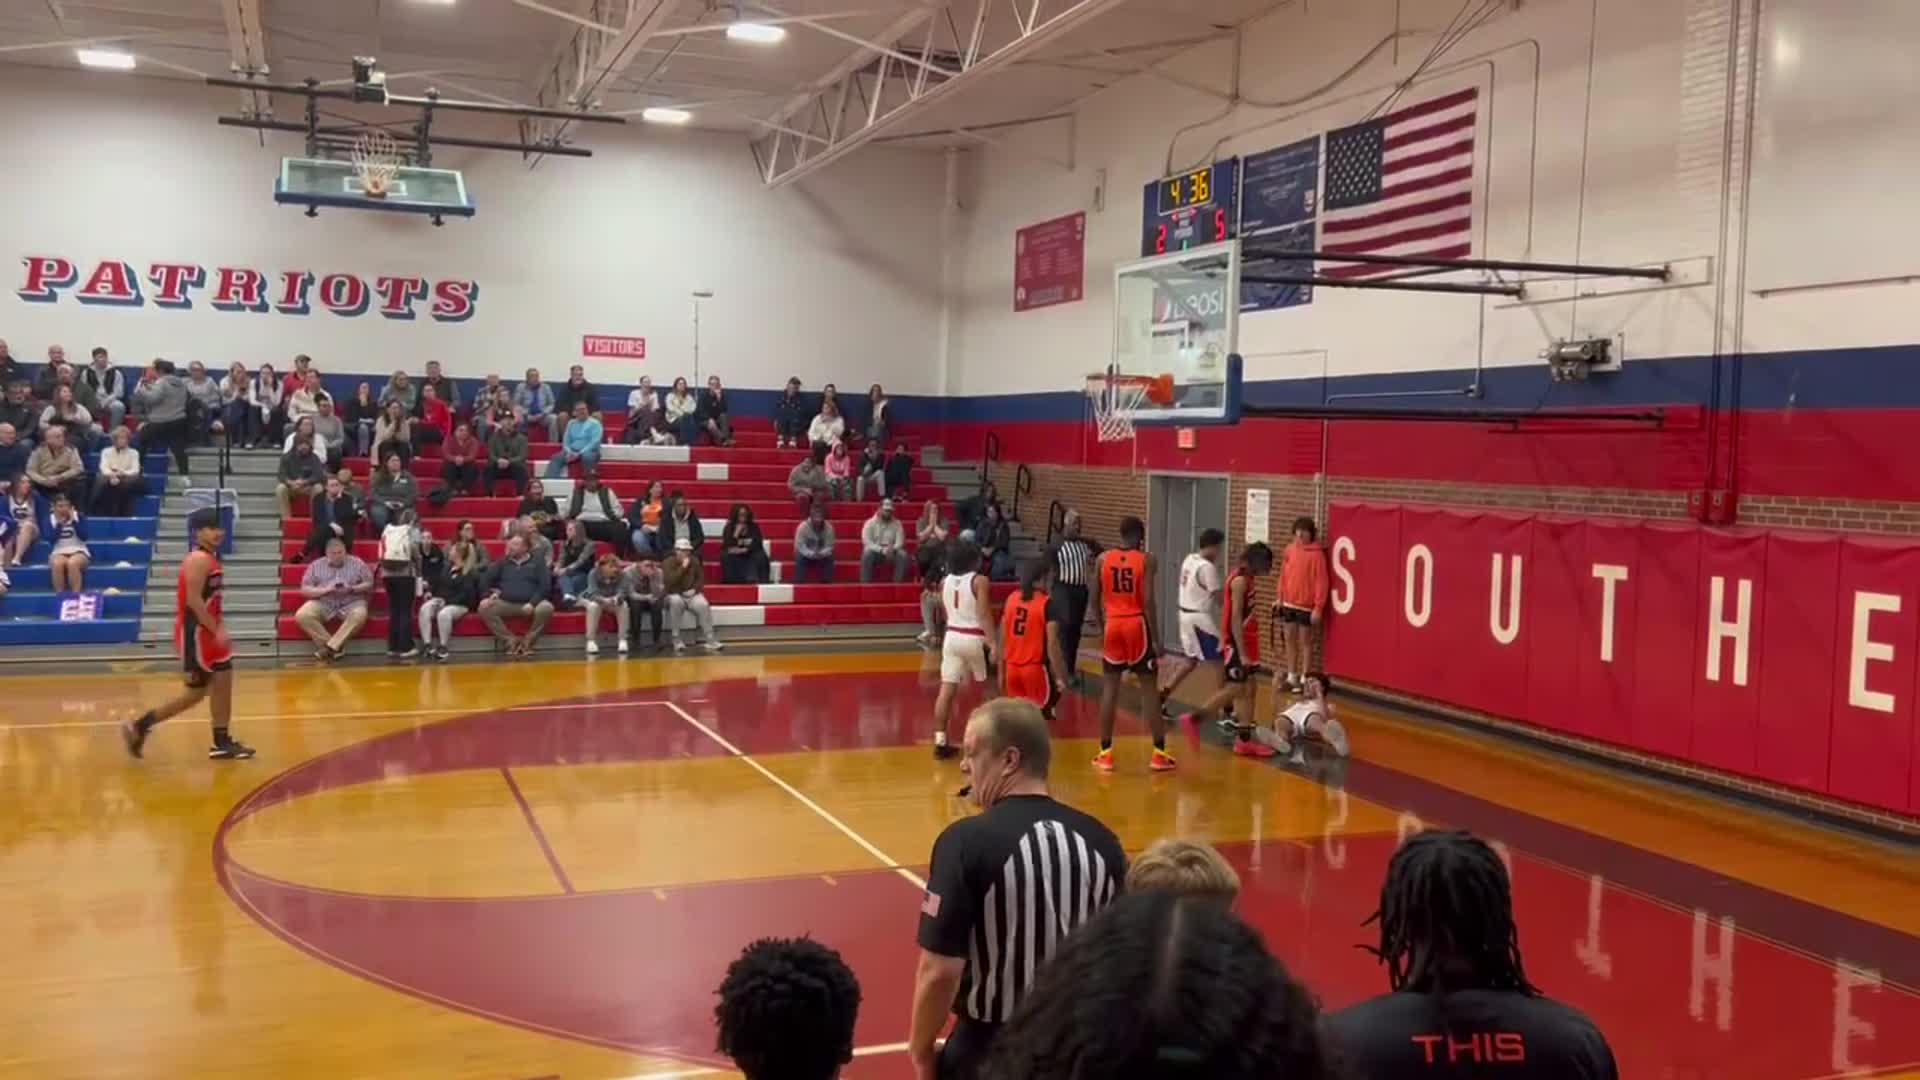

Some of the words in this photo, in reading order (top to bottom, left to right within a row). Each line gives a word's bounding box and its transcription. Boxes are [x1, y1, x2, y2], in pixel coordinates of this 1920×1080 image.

[1156, 224, 1168, 254] 2
[1215, 208, 1226, 242] 5
[17, 256, 480, 323] PATRIOTS
[585, 338, 643, 355] VISITORS
[954, 590, 960, 609] 1
[1013, 607, 1028, 636] 2
[1331, 535, 1901, 713] SOUTHE
[1411, 1033, 1525, 1063] THIS
